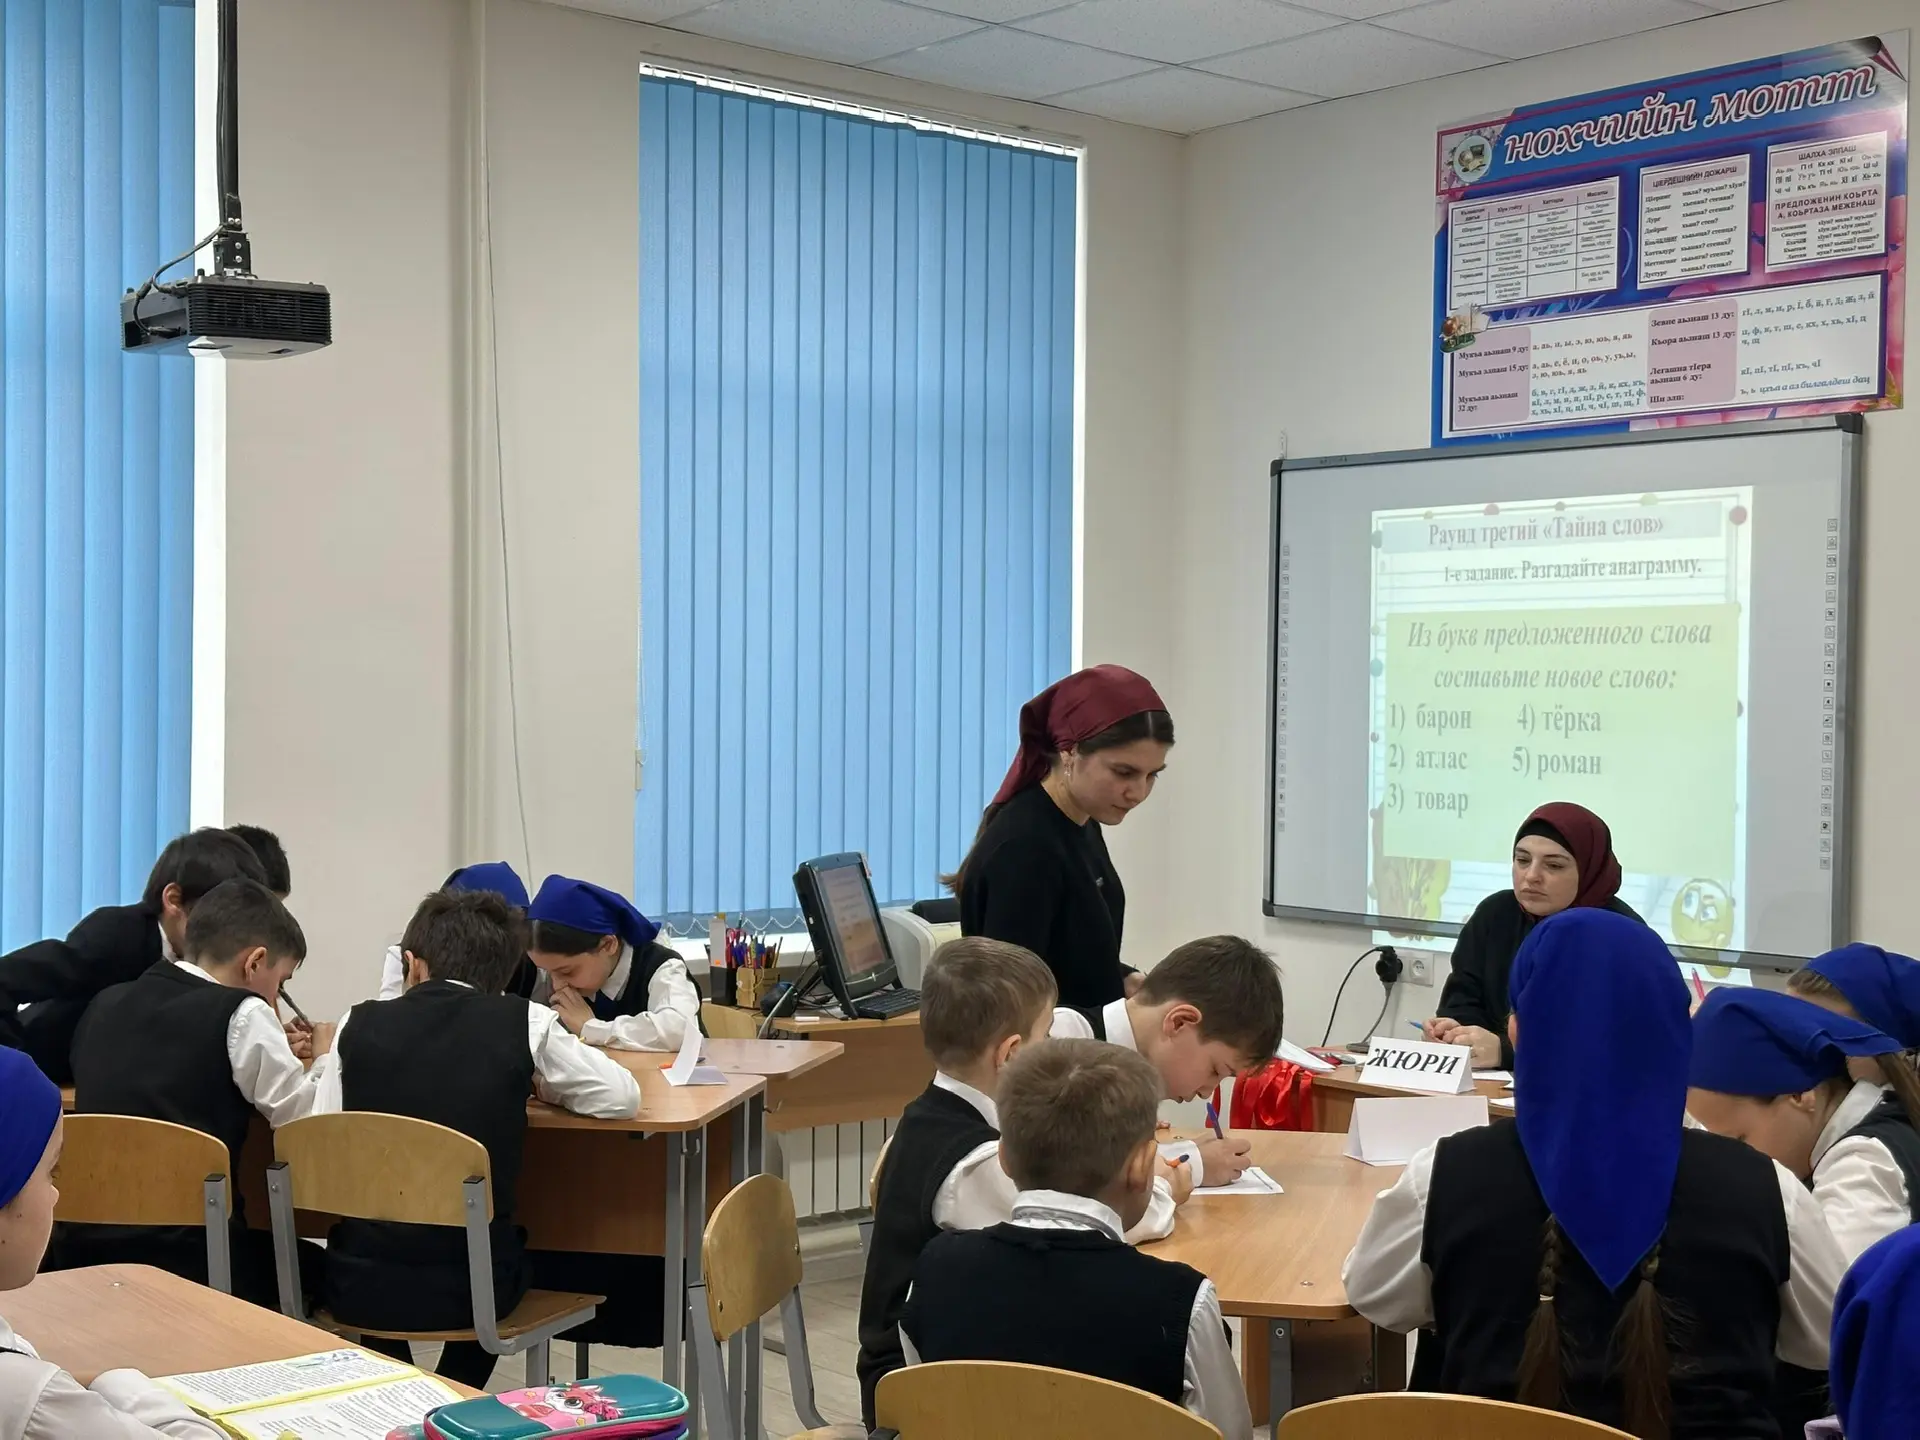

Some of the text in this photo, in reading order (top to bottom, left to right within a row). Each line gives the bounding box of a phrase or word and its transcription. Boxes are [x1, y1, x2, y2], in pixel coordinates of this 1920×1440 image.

[1799, 146, 1856, 160] ШАЛХА ЭЛПАШ
[1704, 167, 1737, 177] ДОЖАРШ
[1775, 189, 1878, 210] ПРЕДЛОЖЕНИН КОЬРТА
[1788, 206, 1829, 218] КОЬРТАЗА
[1832, 200, 1876, 211] МЕЖЕНАШ
[1428, 516, 1664, 550] Раунд третий «Тайна слов»
[1444, 558, 1702, 582] 1-е задание. Разгадайте анаграмму.
[1408, 620, 1711, 653] Из букв предложенного слова
[1434, 668, 1676, 689] составьте новое слово:
[1390, 703, 1601, 738] 1) барон 4) тёрка
[1389, 743, 1602, 779] 2) атлас 5) роман
[1388, 782, 1468, 818] 3) товар
[1367, 1048, 1461, 1074] ЖЮРИ
